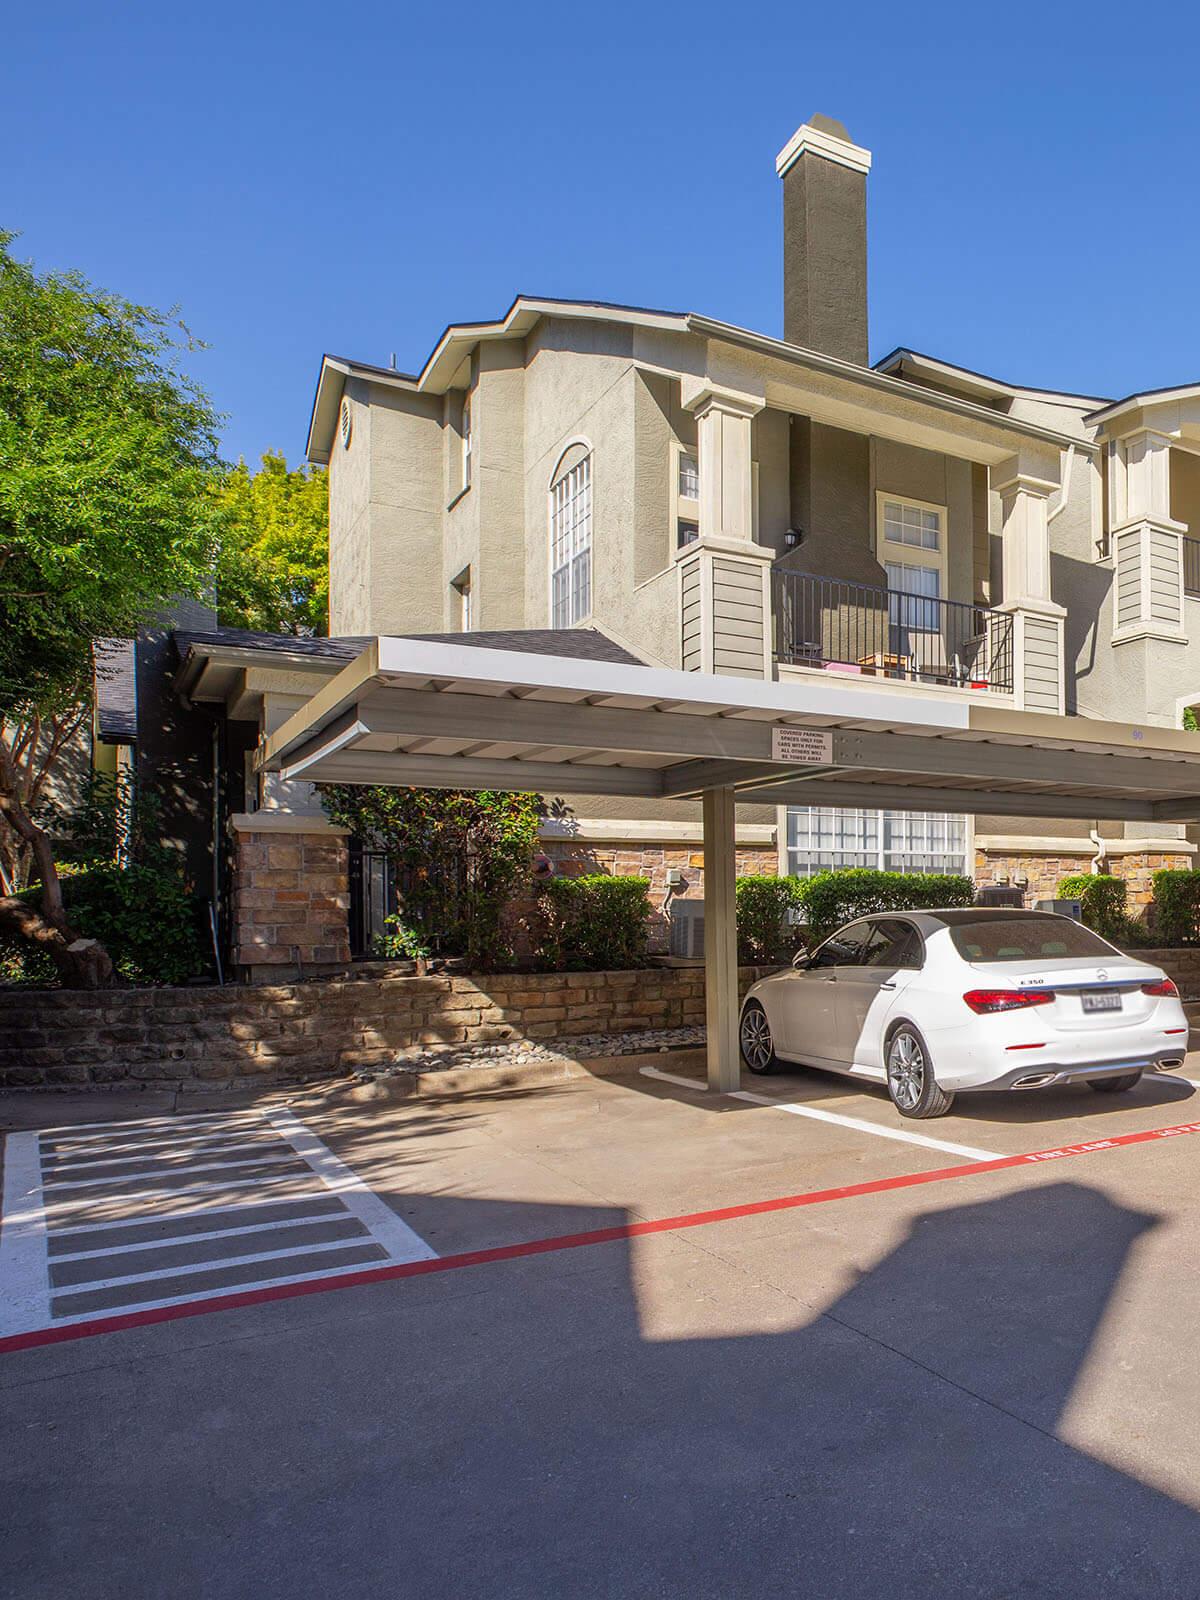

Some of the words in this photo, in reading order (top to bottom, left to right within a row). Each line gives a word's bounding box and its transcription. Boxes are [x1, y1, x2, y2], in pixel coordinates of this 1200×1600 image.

[1132, 729, 1144, 740] 90
[1024, 1149, 1071, 1162] FIRE
[1068, 1140, 1120, 1154] LANE
